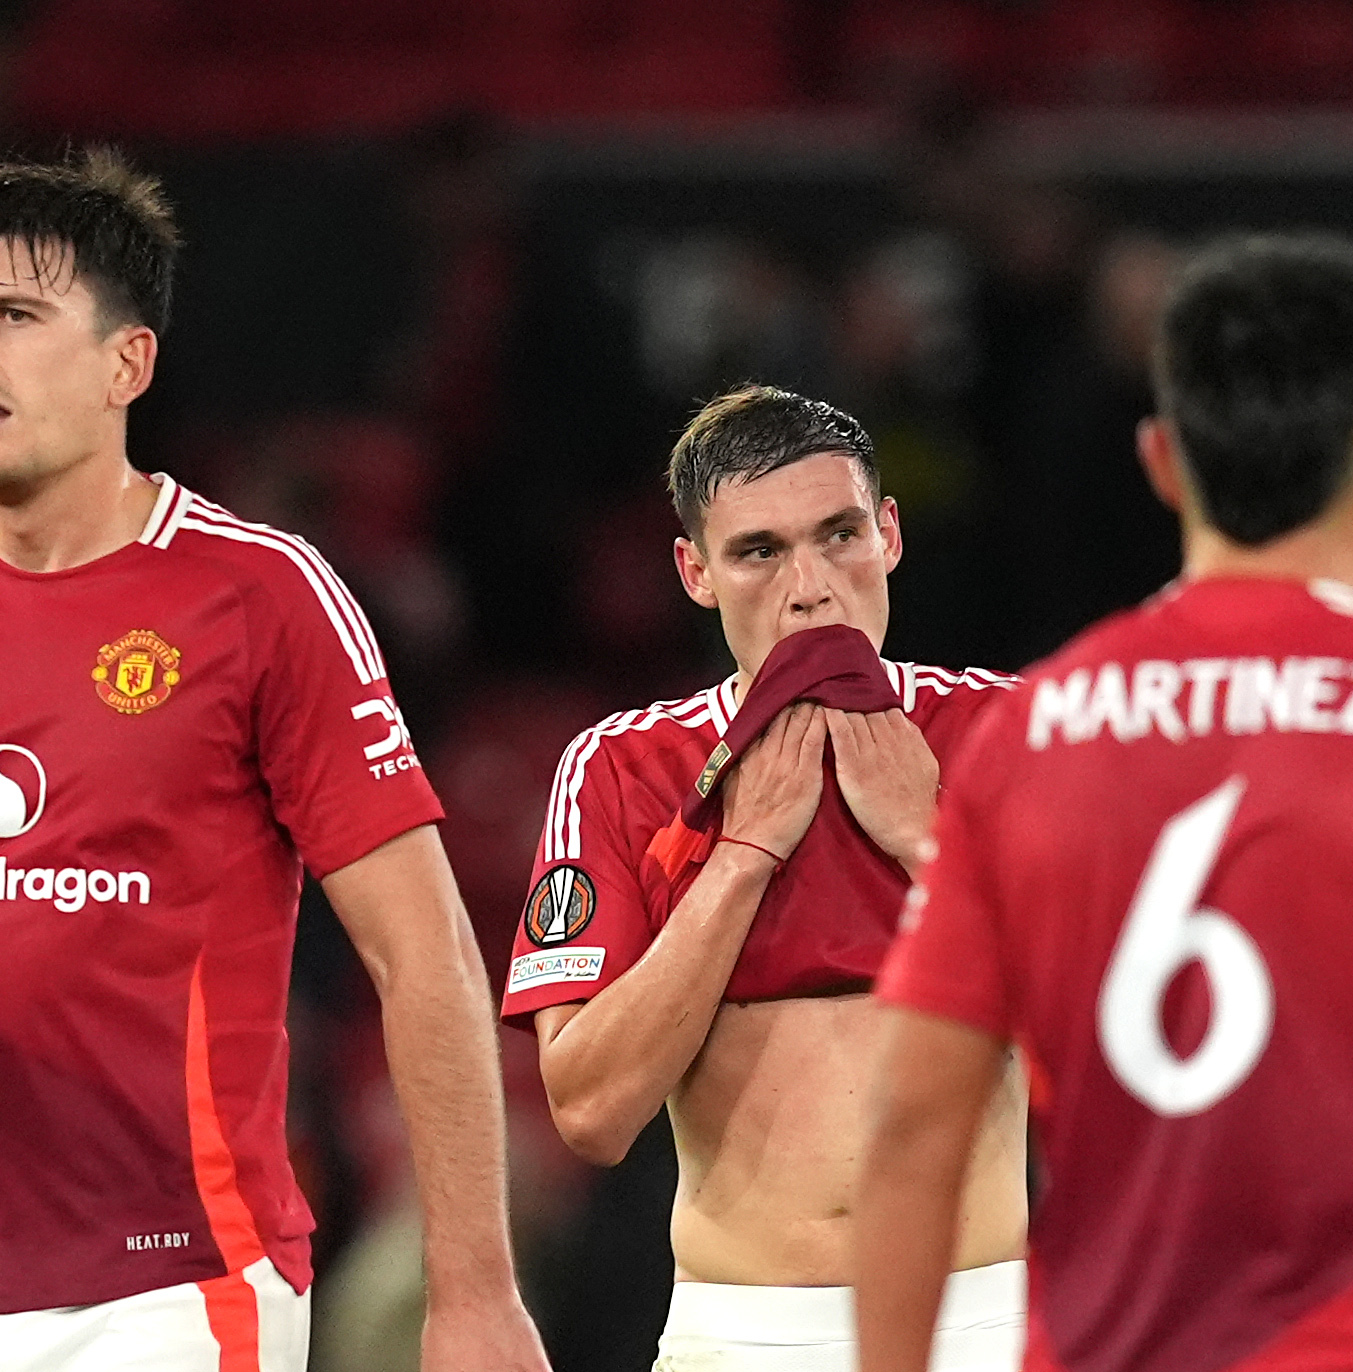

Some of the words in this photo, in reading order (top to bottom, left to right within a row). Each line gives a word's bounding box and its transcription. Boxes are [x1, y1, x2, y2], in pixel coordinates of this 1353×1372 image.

[104, 635, 173, 665] MANCHESTER
[107, 692, 158, 708] UNITED
[1098, 777, 1273, 1116] 6
[512, 957, 601, 980] FOUNDATION
[126, 1232, 190, 1251] HEAT.RDY
